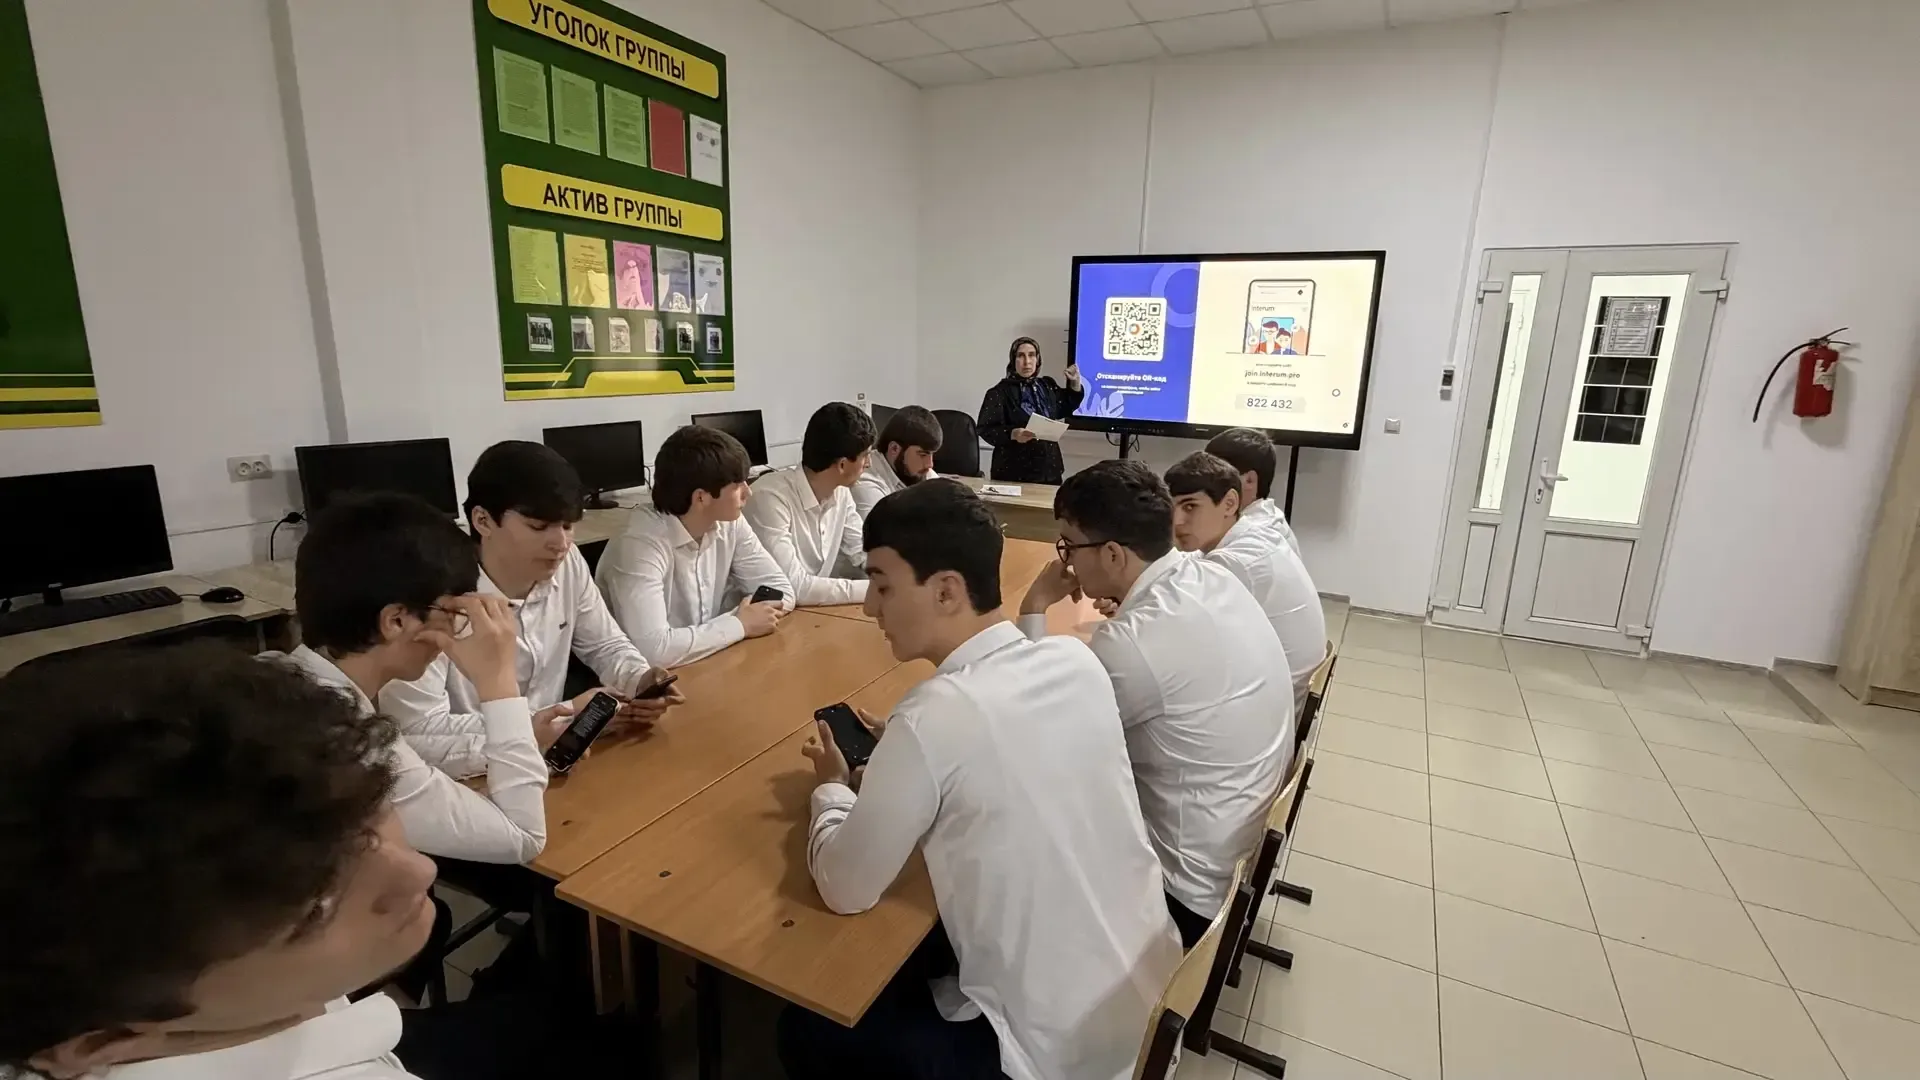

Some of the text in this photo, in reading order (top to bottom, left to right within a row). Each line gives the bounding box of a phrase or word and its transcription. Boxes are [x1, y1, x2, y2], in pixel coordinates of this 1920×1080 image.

[528, 0, 686, 82] УГОЛОК ГРУППЫ
[542, 182, 683, 229] АКТИВ ГРУППЫ
[1246, 397, 1293, 410] 822 432
